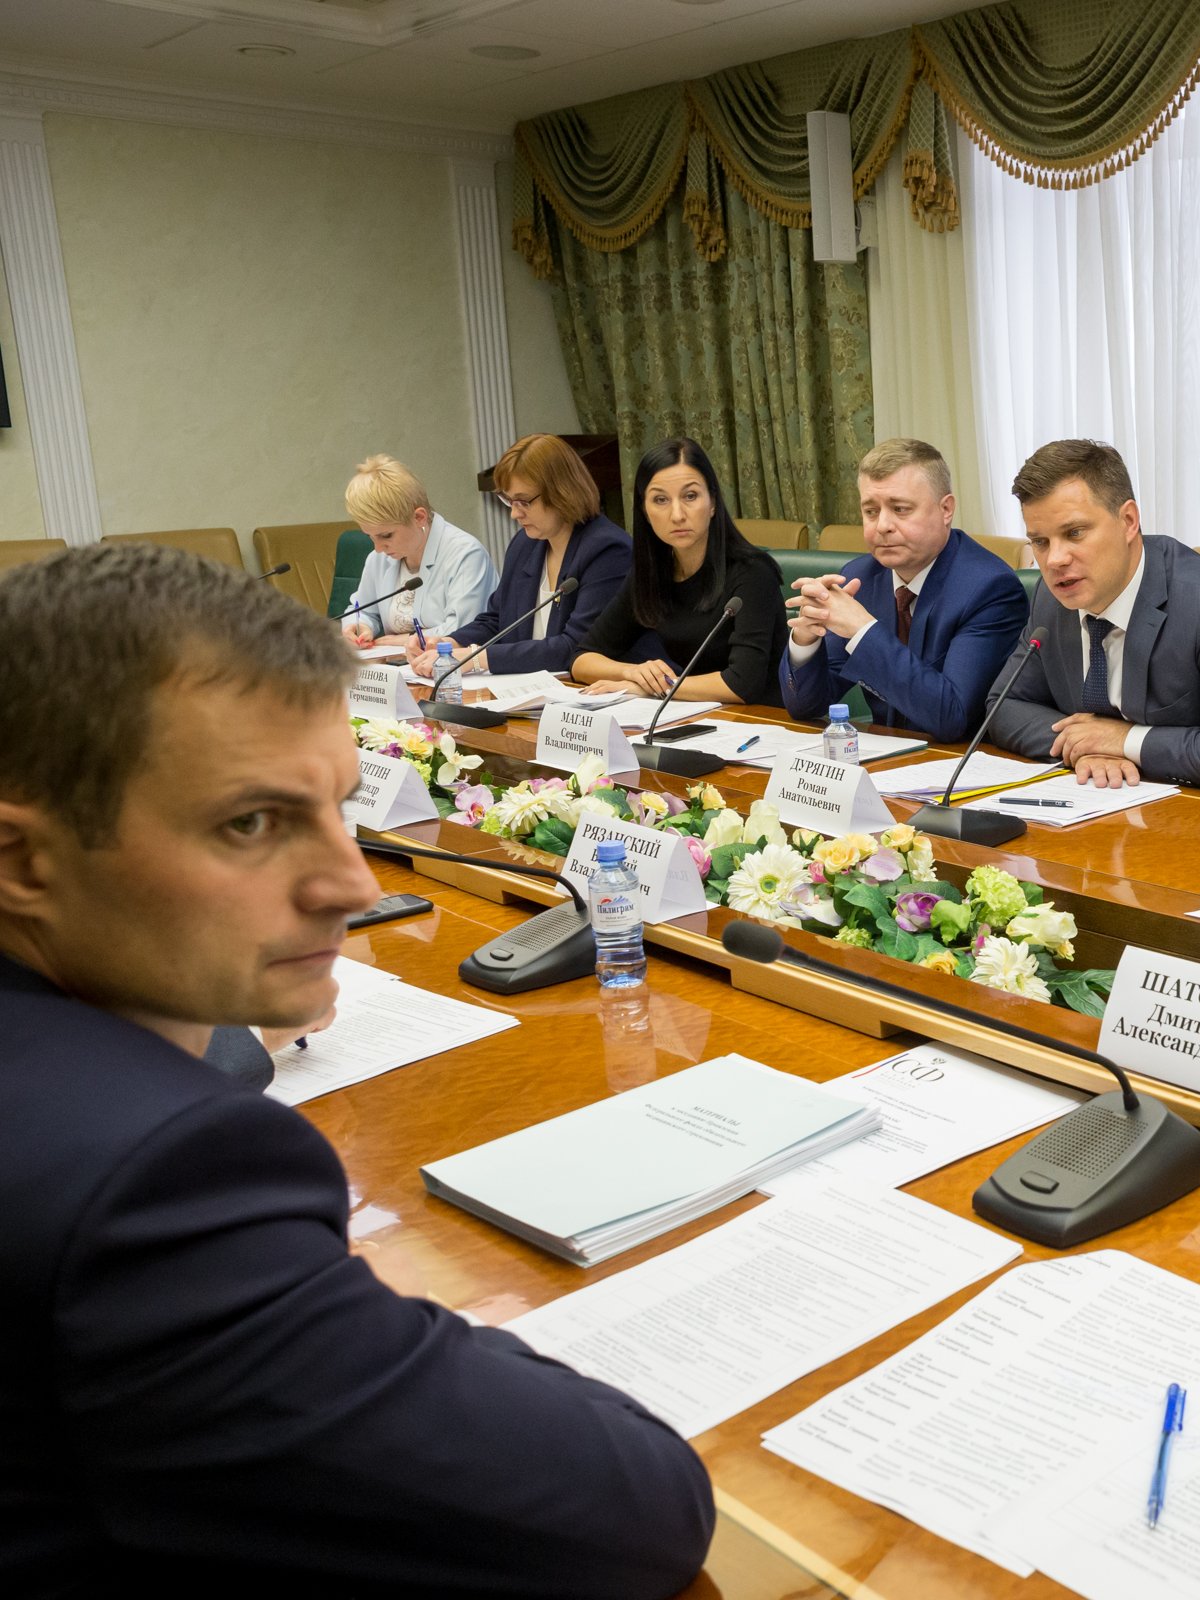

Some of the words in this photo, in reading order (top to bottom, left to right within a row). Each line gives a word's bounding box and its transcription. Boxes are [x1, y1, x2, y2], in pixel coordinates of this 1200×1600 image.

[349, 690, 388, 705] Германовна
[561, 711, 594, 728] МАГАН
[561, 727, 588, 742] Сергей
[789, 757, 846, 781] ДУРЯГИН
[796, 777, 828, 796] Роман
[778, 786, 841, 814] Анатольевич
